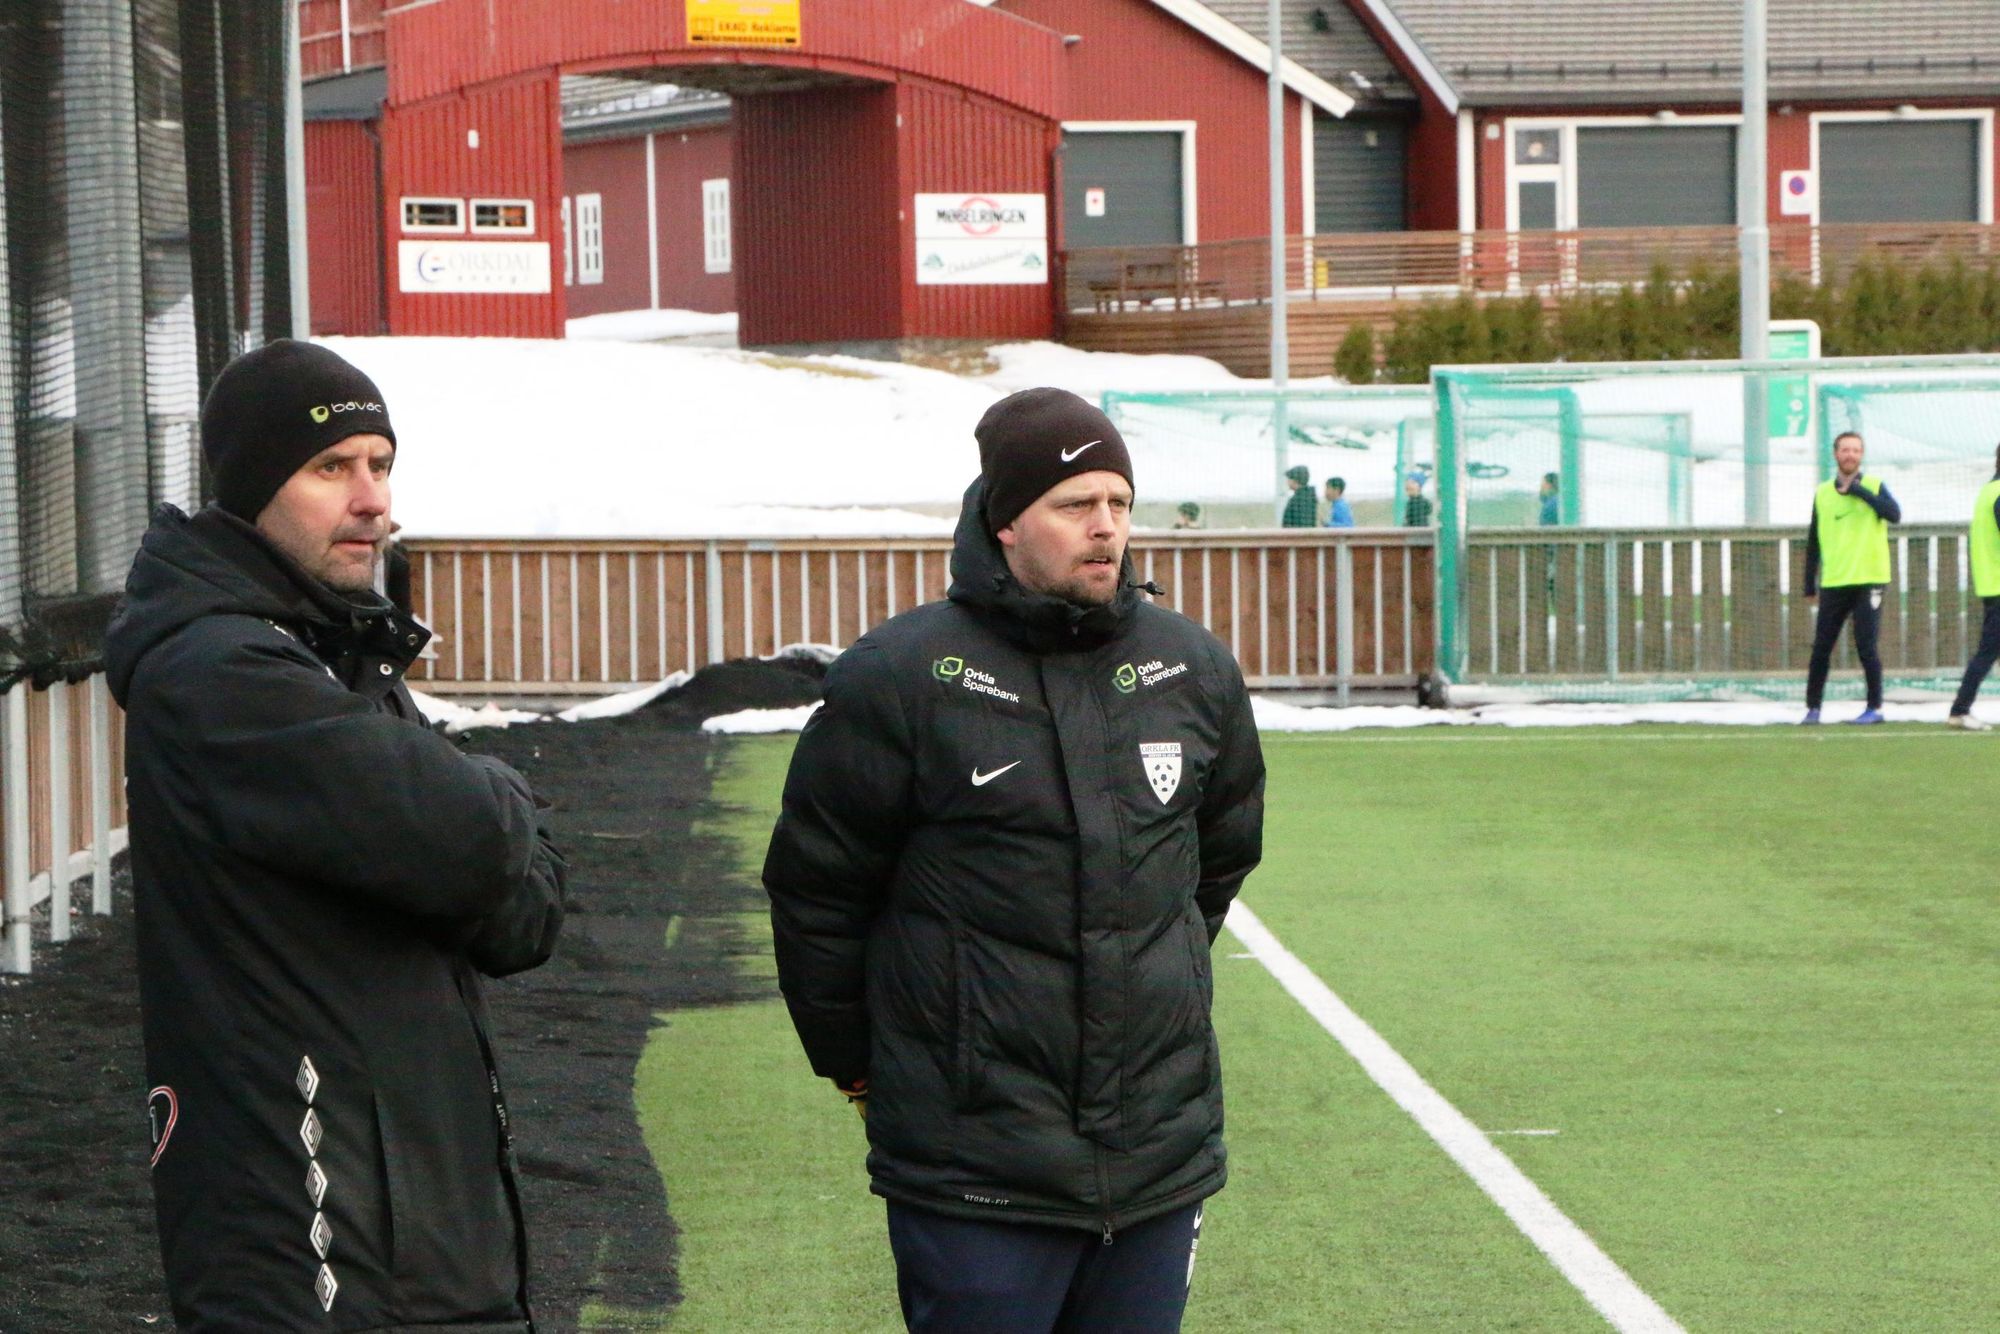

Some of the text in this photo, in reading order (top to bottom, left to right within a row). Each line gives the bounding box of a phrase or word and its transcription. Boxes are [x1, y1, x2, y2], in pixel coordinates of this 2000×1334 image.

[936, 209, 1026, 223] MØBELRINGEN
[448, 252, 532, 271] ORKDAL
[964, 667, 995, 685] Orkla
[1137, 660, 1163, 676] Orkla
[1141, 662, 1188, 686] Sparebank
[962, 677, 1019, 704] Sparebank
[1141, 744, 1180, 753] ORKLA FK
[964, 1194, 1010, 1206] STORM-FIT
